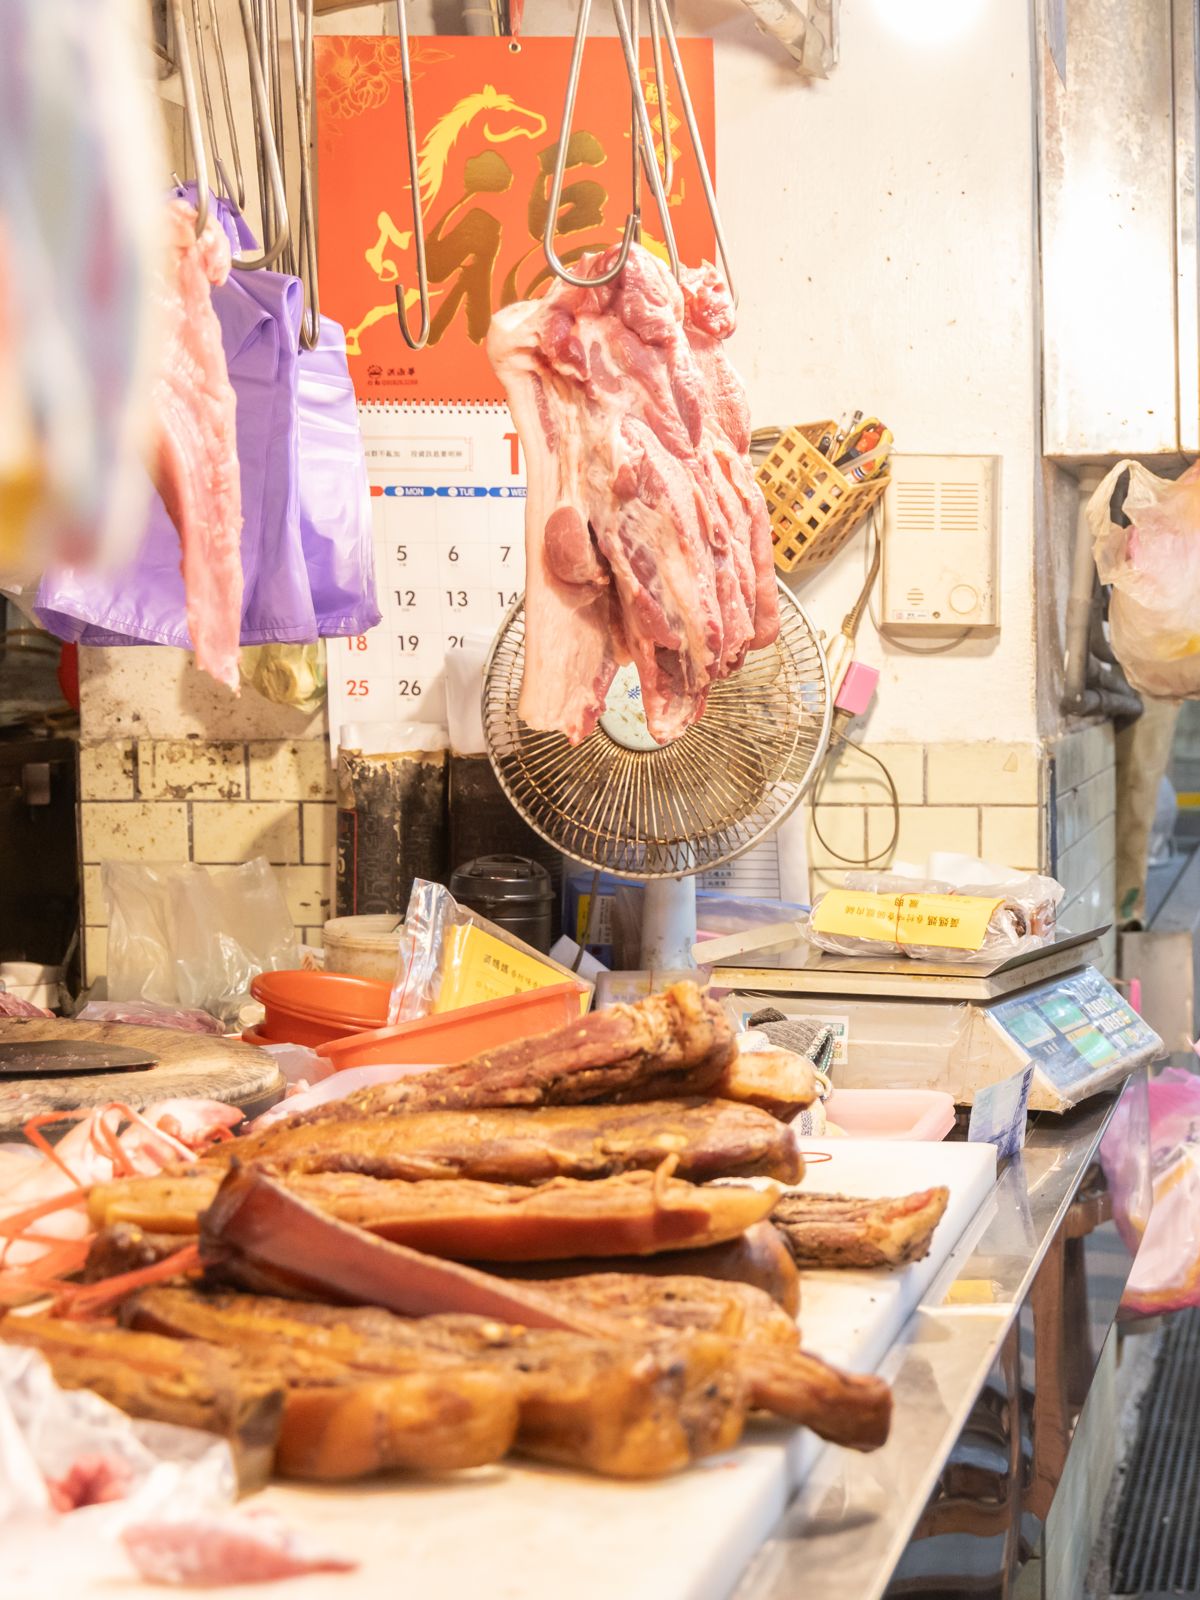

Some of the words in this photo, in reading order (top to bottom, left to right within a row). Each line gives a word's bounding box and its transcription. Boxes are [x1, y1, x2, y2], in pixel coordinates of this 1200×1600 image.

[405, 487, 424, 496] MON
[459, 487, 475, 497] TUE
[397, 545, 407, 561] 5
[448, 545, 459, 561] 6
[500, 546, 511, 562] 7
[394, 590, 416, 606] 12
[446, 591, 468, 607] 13
[497, 591, 518, 607] 14
[347, 635, 368, 651] 18
[398, 635, 420, 651] 19
[346, 680, 369, 696] 25
[398, 680, 421, 696] 26
